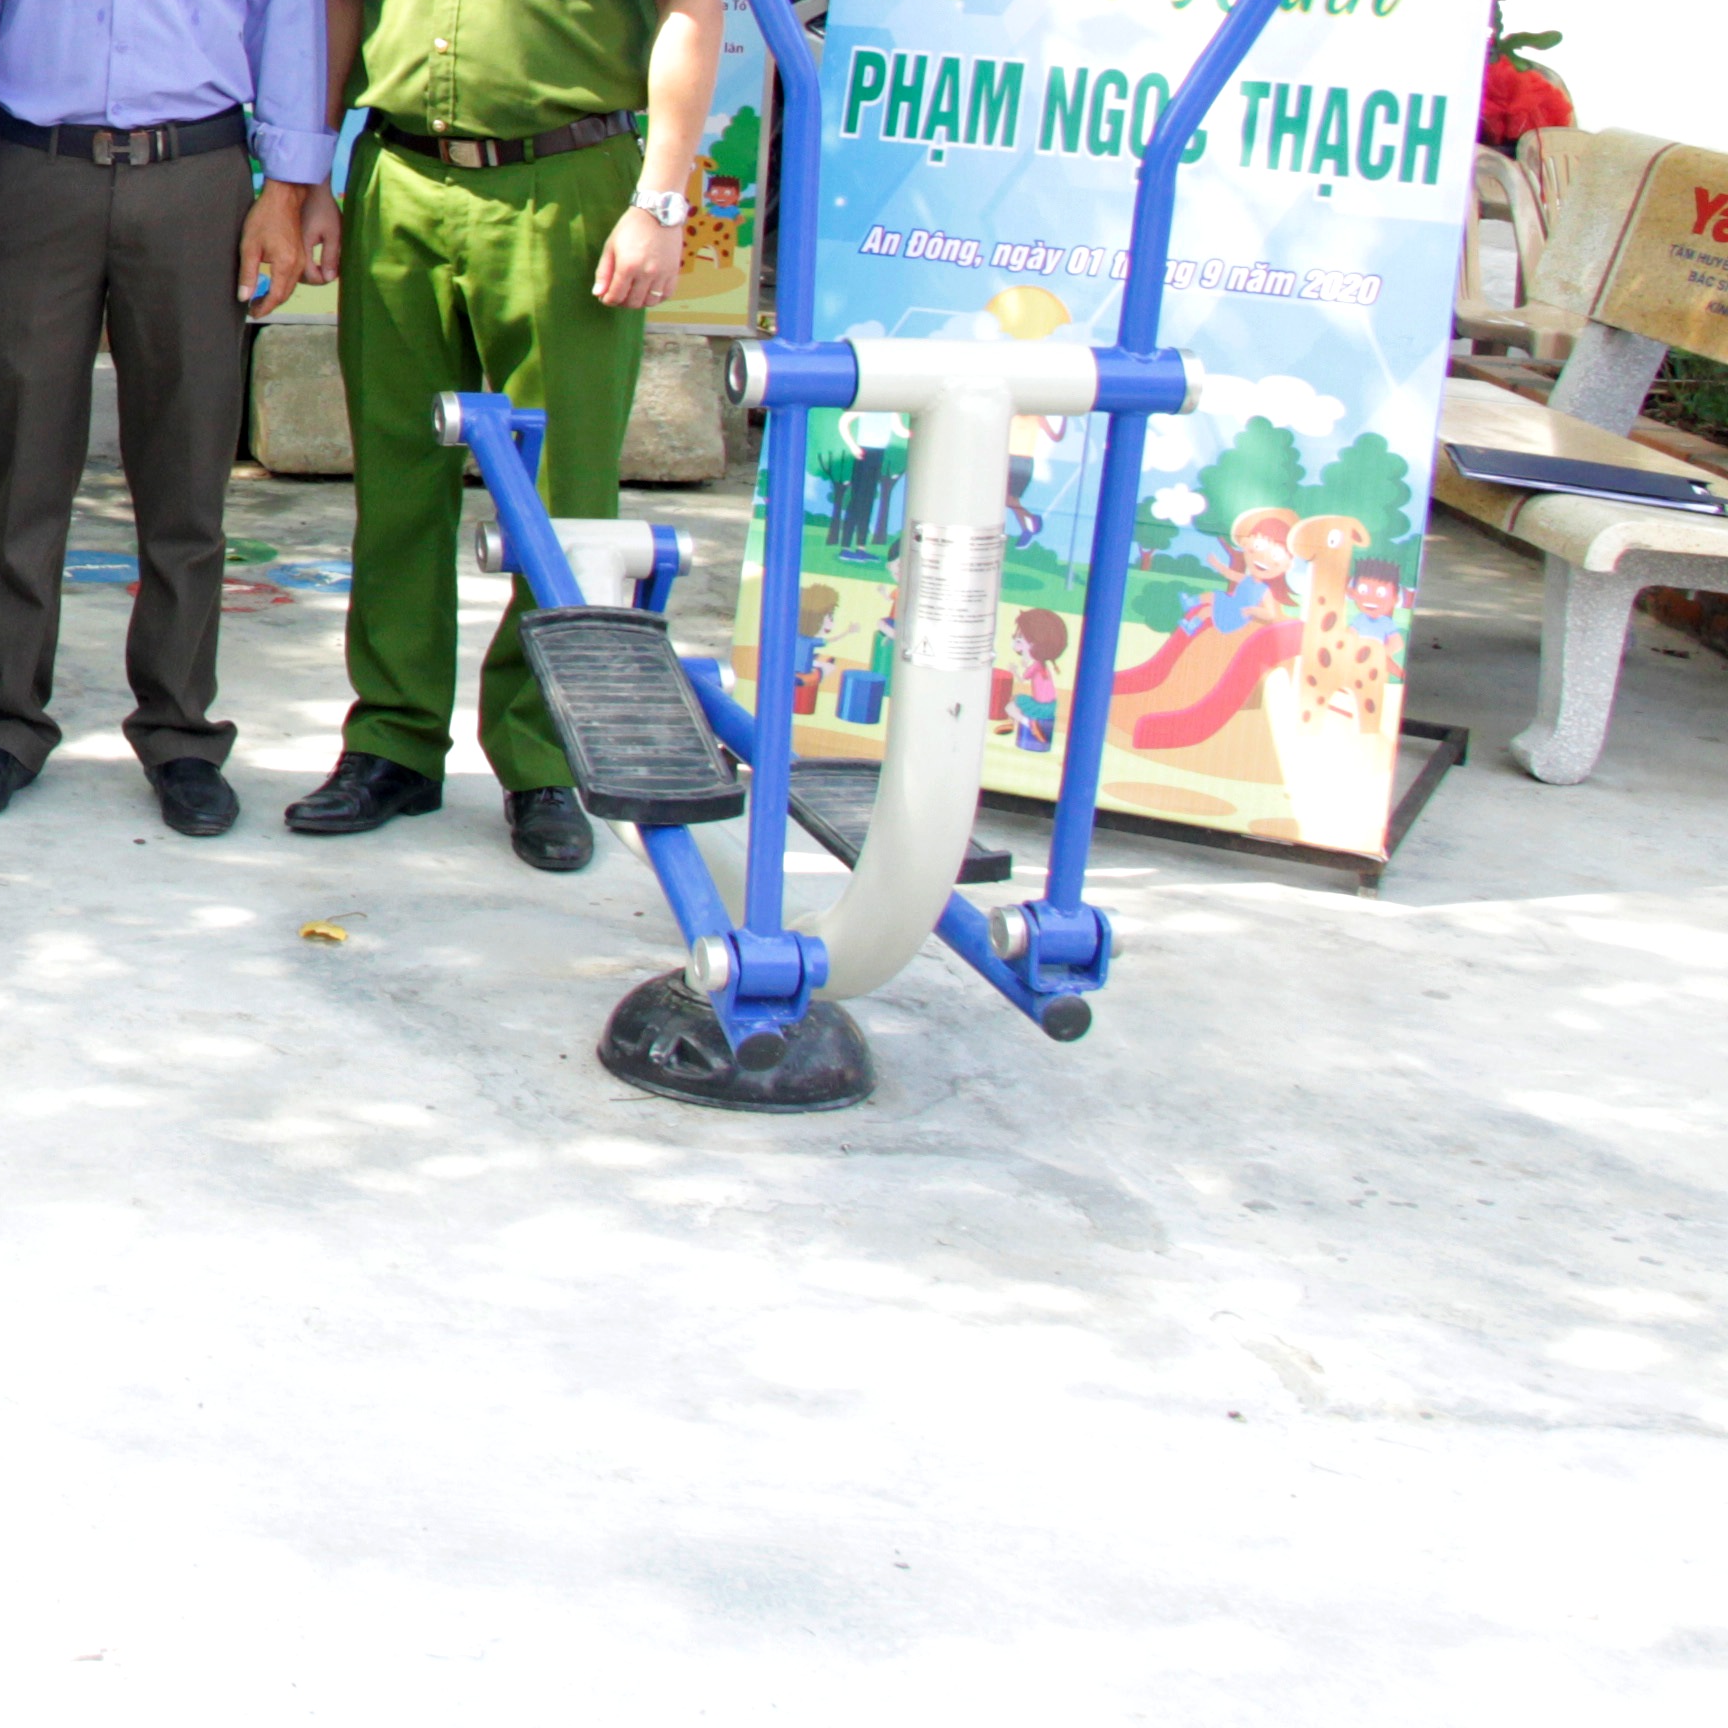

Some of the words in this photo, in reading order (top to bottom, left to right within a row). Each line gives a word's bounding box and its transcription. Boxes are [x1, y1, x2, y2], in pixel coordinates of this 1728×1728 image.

[840, 47, 1023, 167] PHẠM
[1240, 80, 1447, 198] THẠCH
[859, 225, 901, 257] An
[905, 229, 983, 268] Đông,
[991, 240, 1063, 275] ngày
[1066, 244, 1103, 277] 01
[1198, 258, 1224, 289] 9
[1225, 260, 1295, 296] năm
[1300, 270, 1382, 306] 2020
